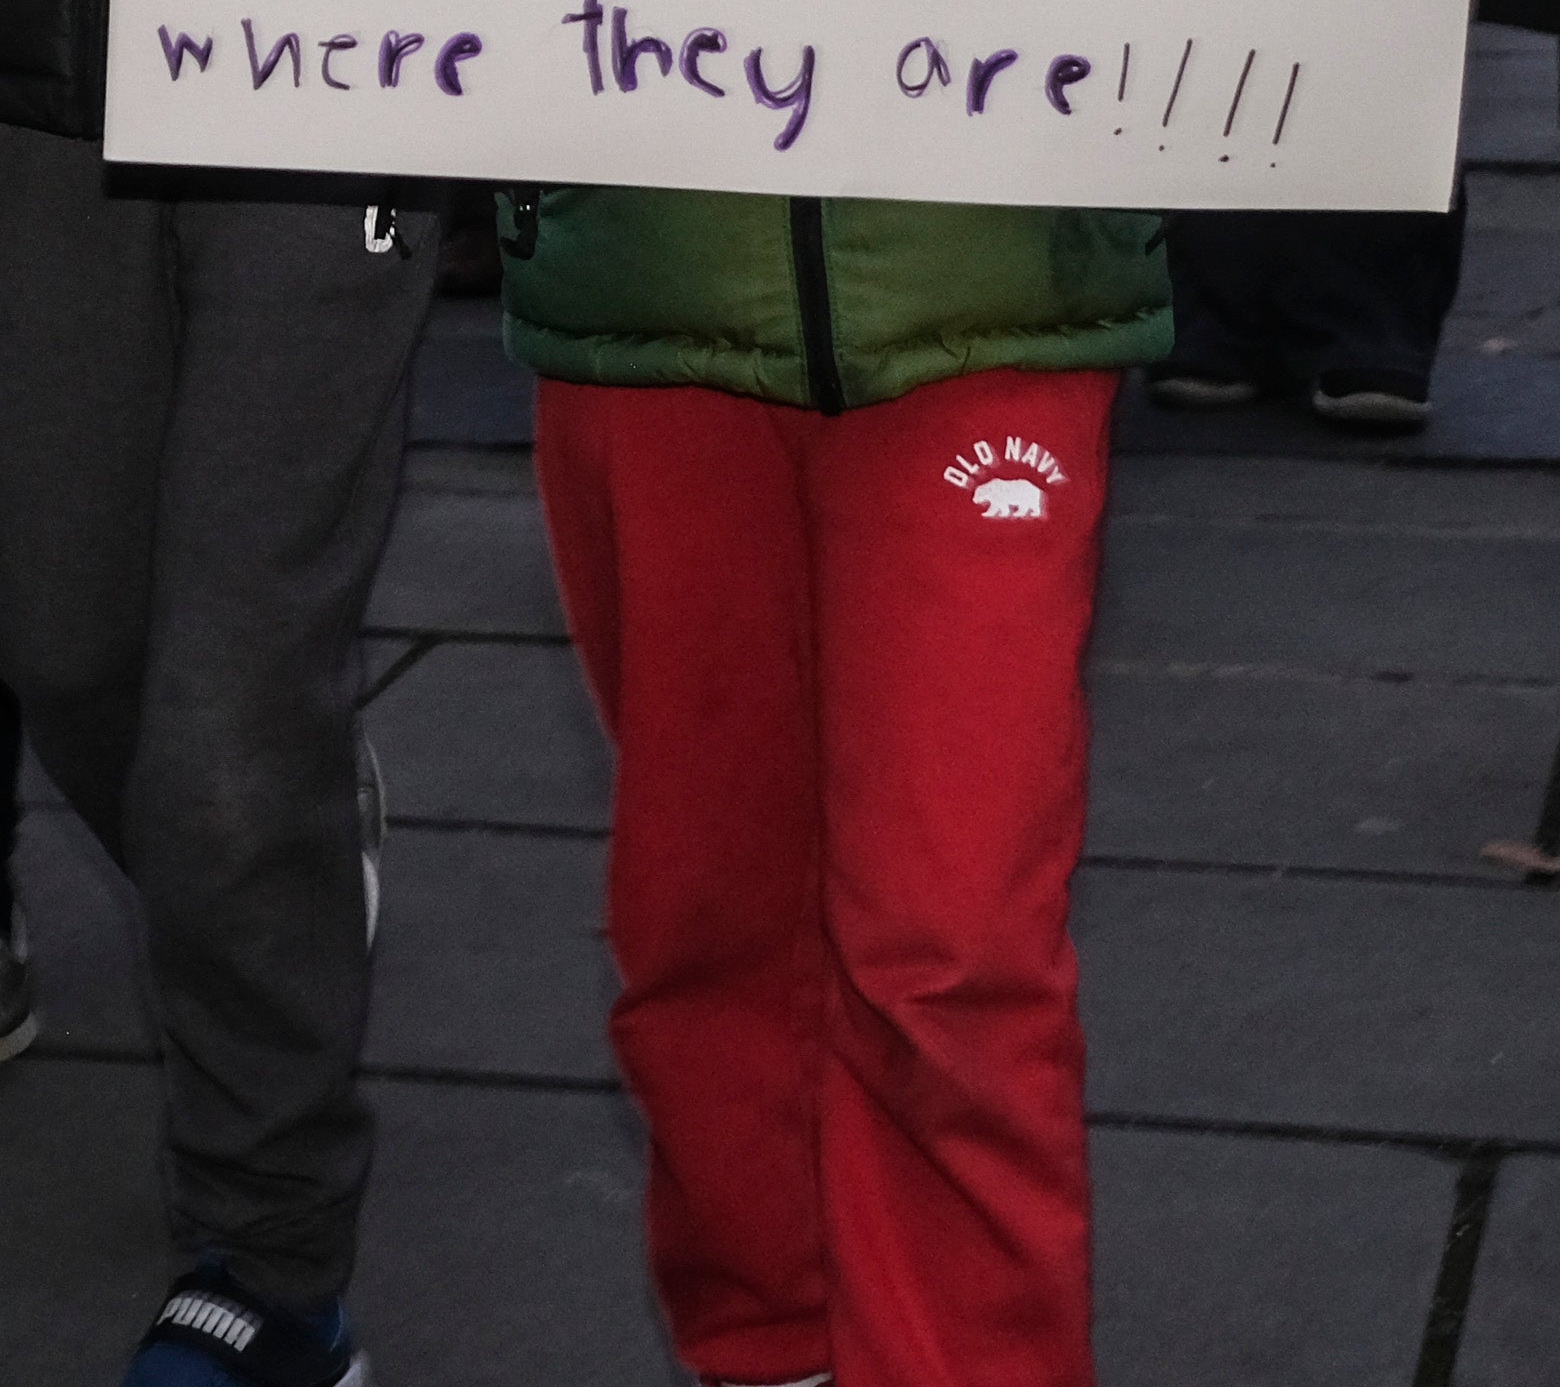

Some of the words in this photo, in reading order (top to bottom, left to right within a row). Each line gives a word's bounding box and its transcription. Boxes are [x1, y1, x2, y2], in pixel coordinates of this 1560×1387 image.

[156, 17, 484, 98] where
[943, 440, 995, 490] OLD
[1005, 435, 1068, 485] NAVY
[156, 1293, 260, 1353] PUMA
